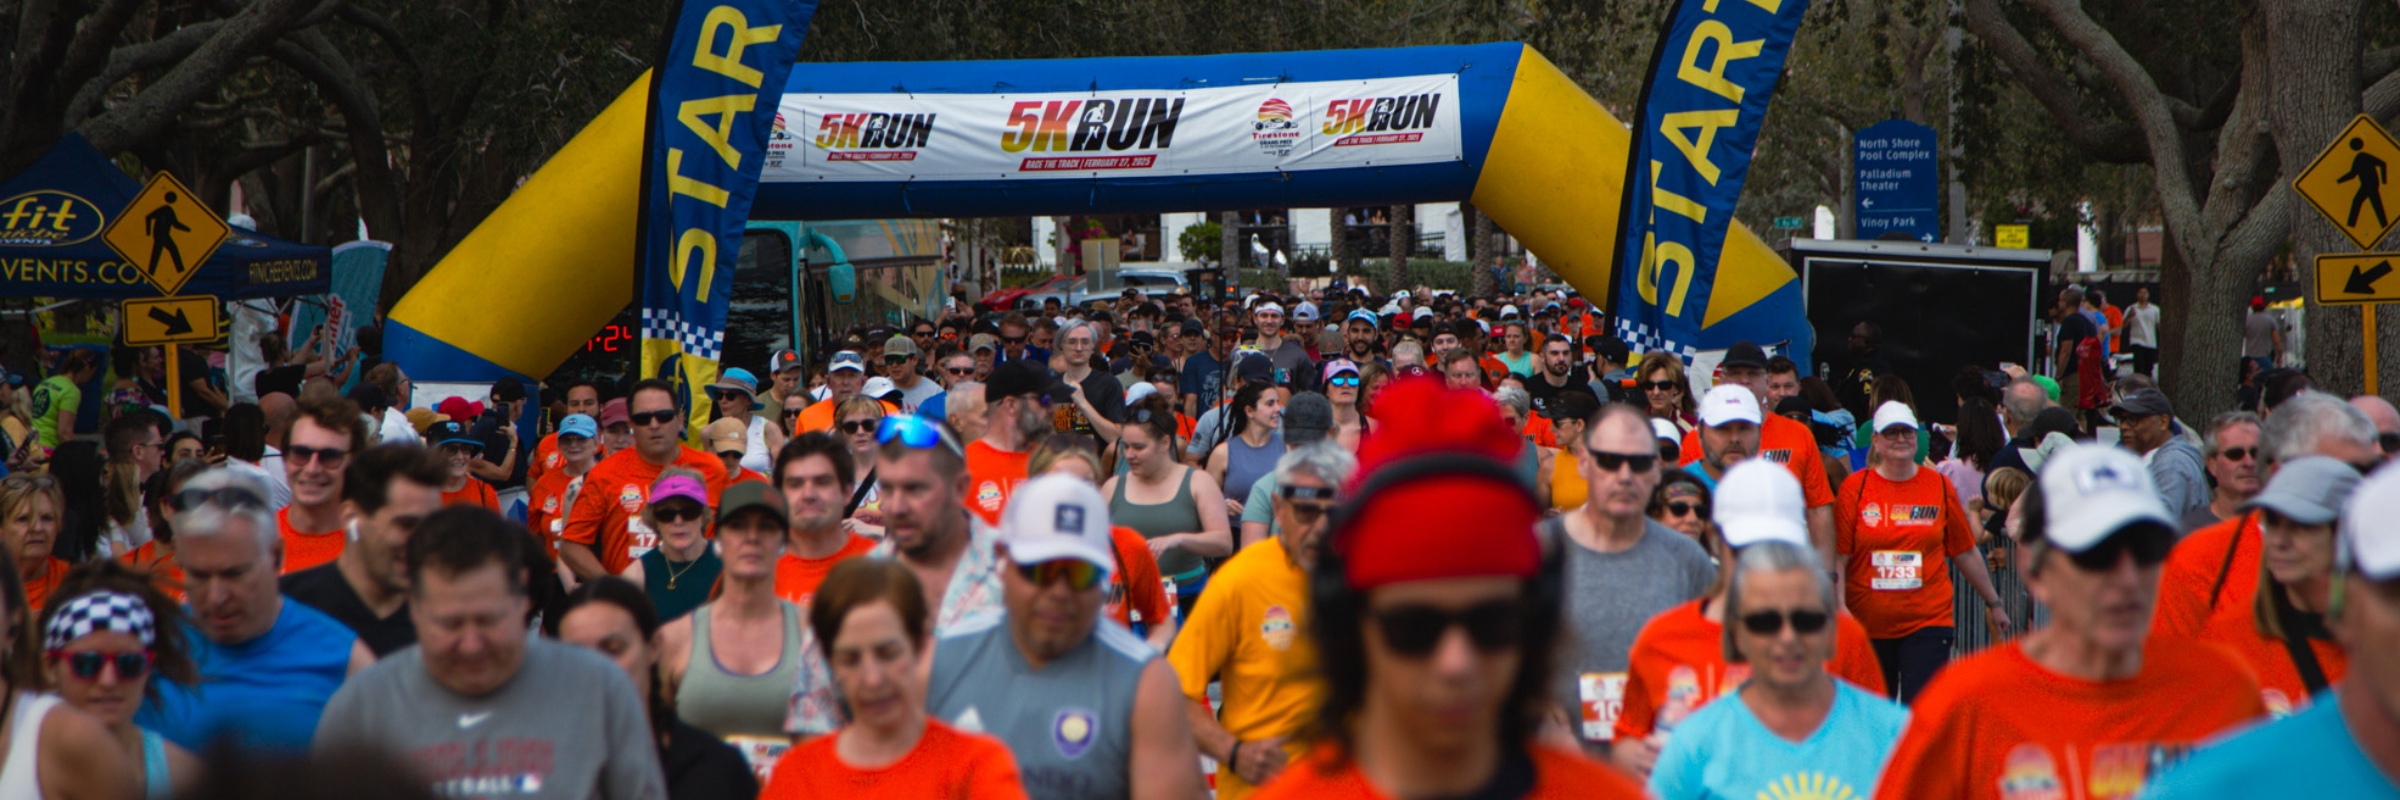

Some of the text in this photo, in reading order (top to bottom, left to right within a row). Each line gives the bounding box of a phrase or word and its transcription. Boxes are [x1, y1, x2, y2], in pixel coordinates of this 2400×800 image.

[1252, 131, 1300, 141] Firestone
[1859, 138, 1921, 149] North Shore
[1859, 150, 1930, 161] Pool Complex
[1024, 159, 1043, 169] RACE
[1044, 159, 1057, 169] THE
[1058, 159, 1079, 169] TRACK
[1084, 158, 1119, 168] FEBRUARY
[1131, 157, 1152, 167] 2025
[1860, 168, 1912, 179] Palladium
[1860, 181, 1900, 191] Theater
[2, 196, 78, 231] fit
[1861, 217, 1916, 230] Vinoy Park
[0, 258, 148, 285] VENTS.CO
[1877, 566, 1916, 579] 1733
